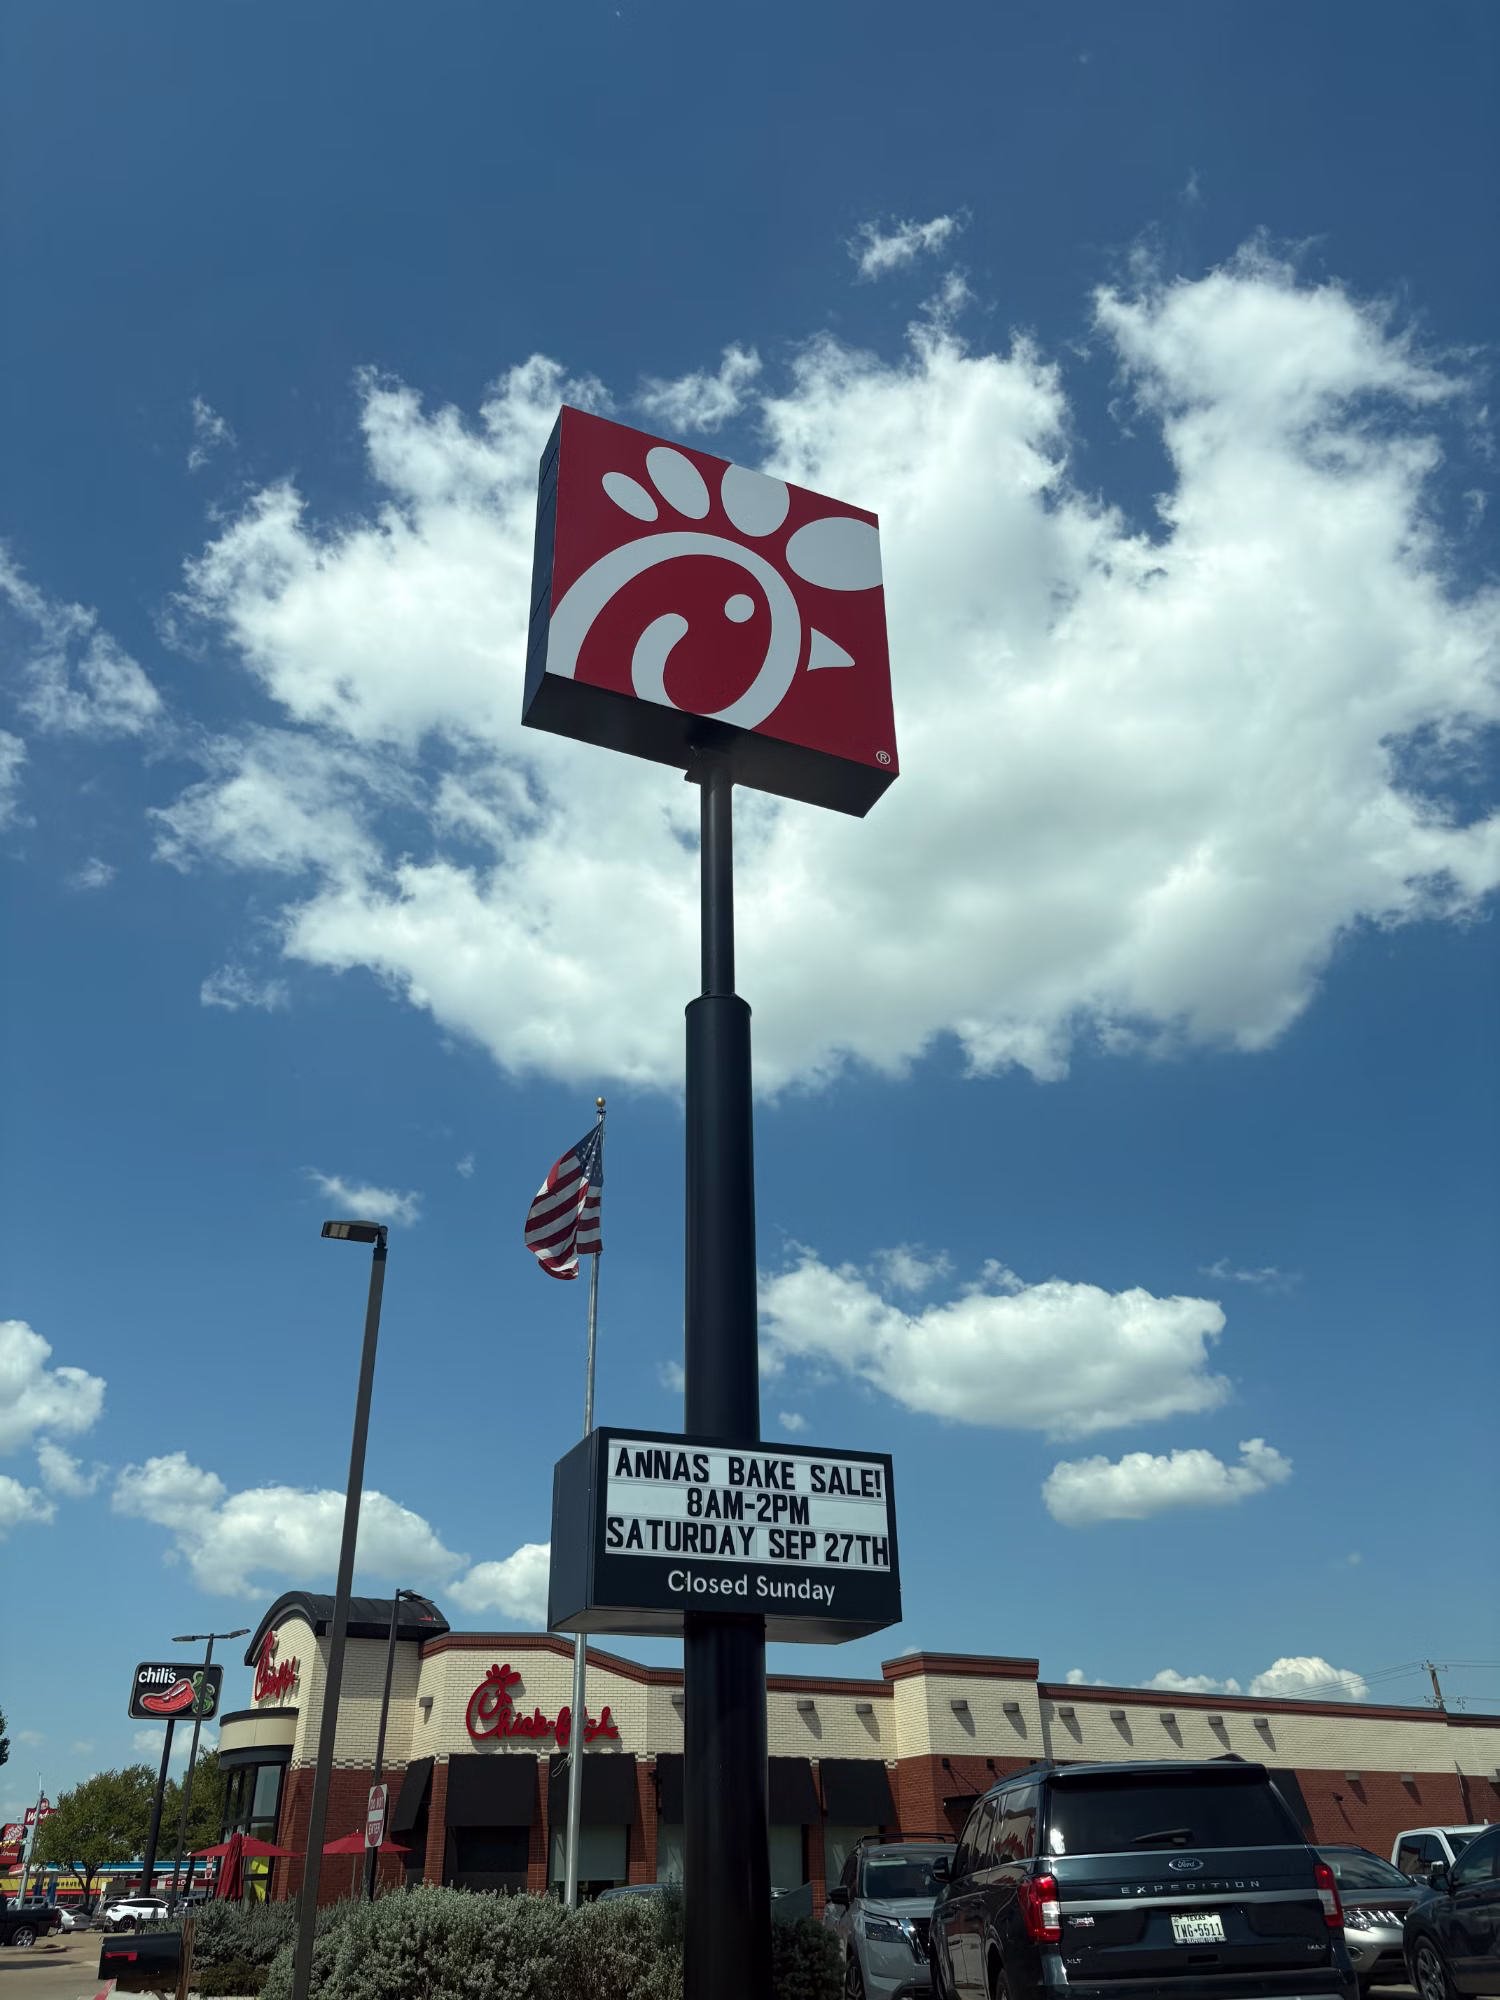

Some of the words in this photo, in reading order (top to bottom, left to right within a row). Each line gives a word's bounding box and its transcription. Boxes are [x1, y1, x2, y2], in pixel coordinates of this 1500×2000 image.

[615, 1447, 710, 1483] ANNAS
[728, 1456, 796, 1491] BAKE
[810, 1464, 882, 1499] SALE!
[687, 1487, 810, 1526] 8AM-2PM
[606, 1516, 755, 1557] SATURDAY
[768, 1528, 817, 1561] SEP
[823, 1532, 889, 1567] 27TH
[667, 1569, 749, 1597] Closed
[755, 1574, 836, 1607] Sunday
[138, 1666, 177, 1684] chili's
[1120, 1880, 1260, 1894] EXPEDITION
